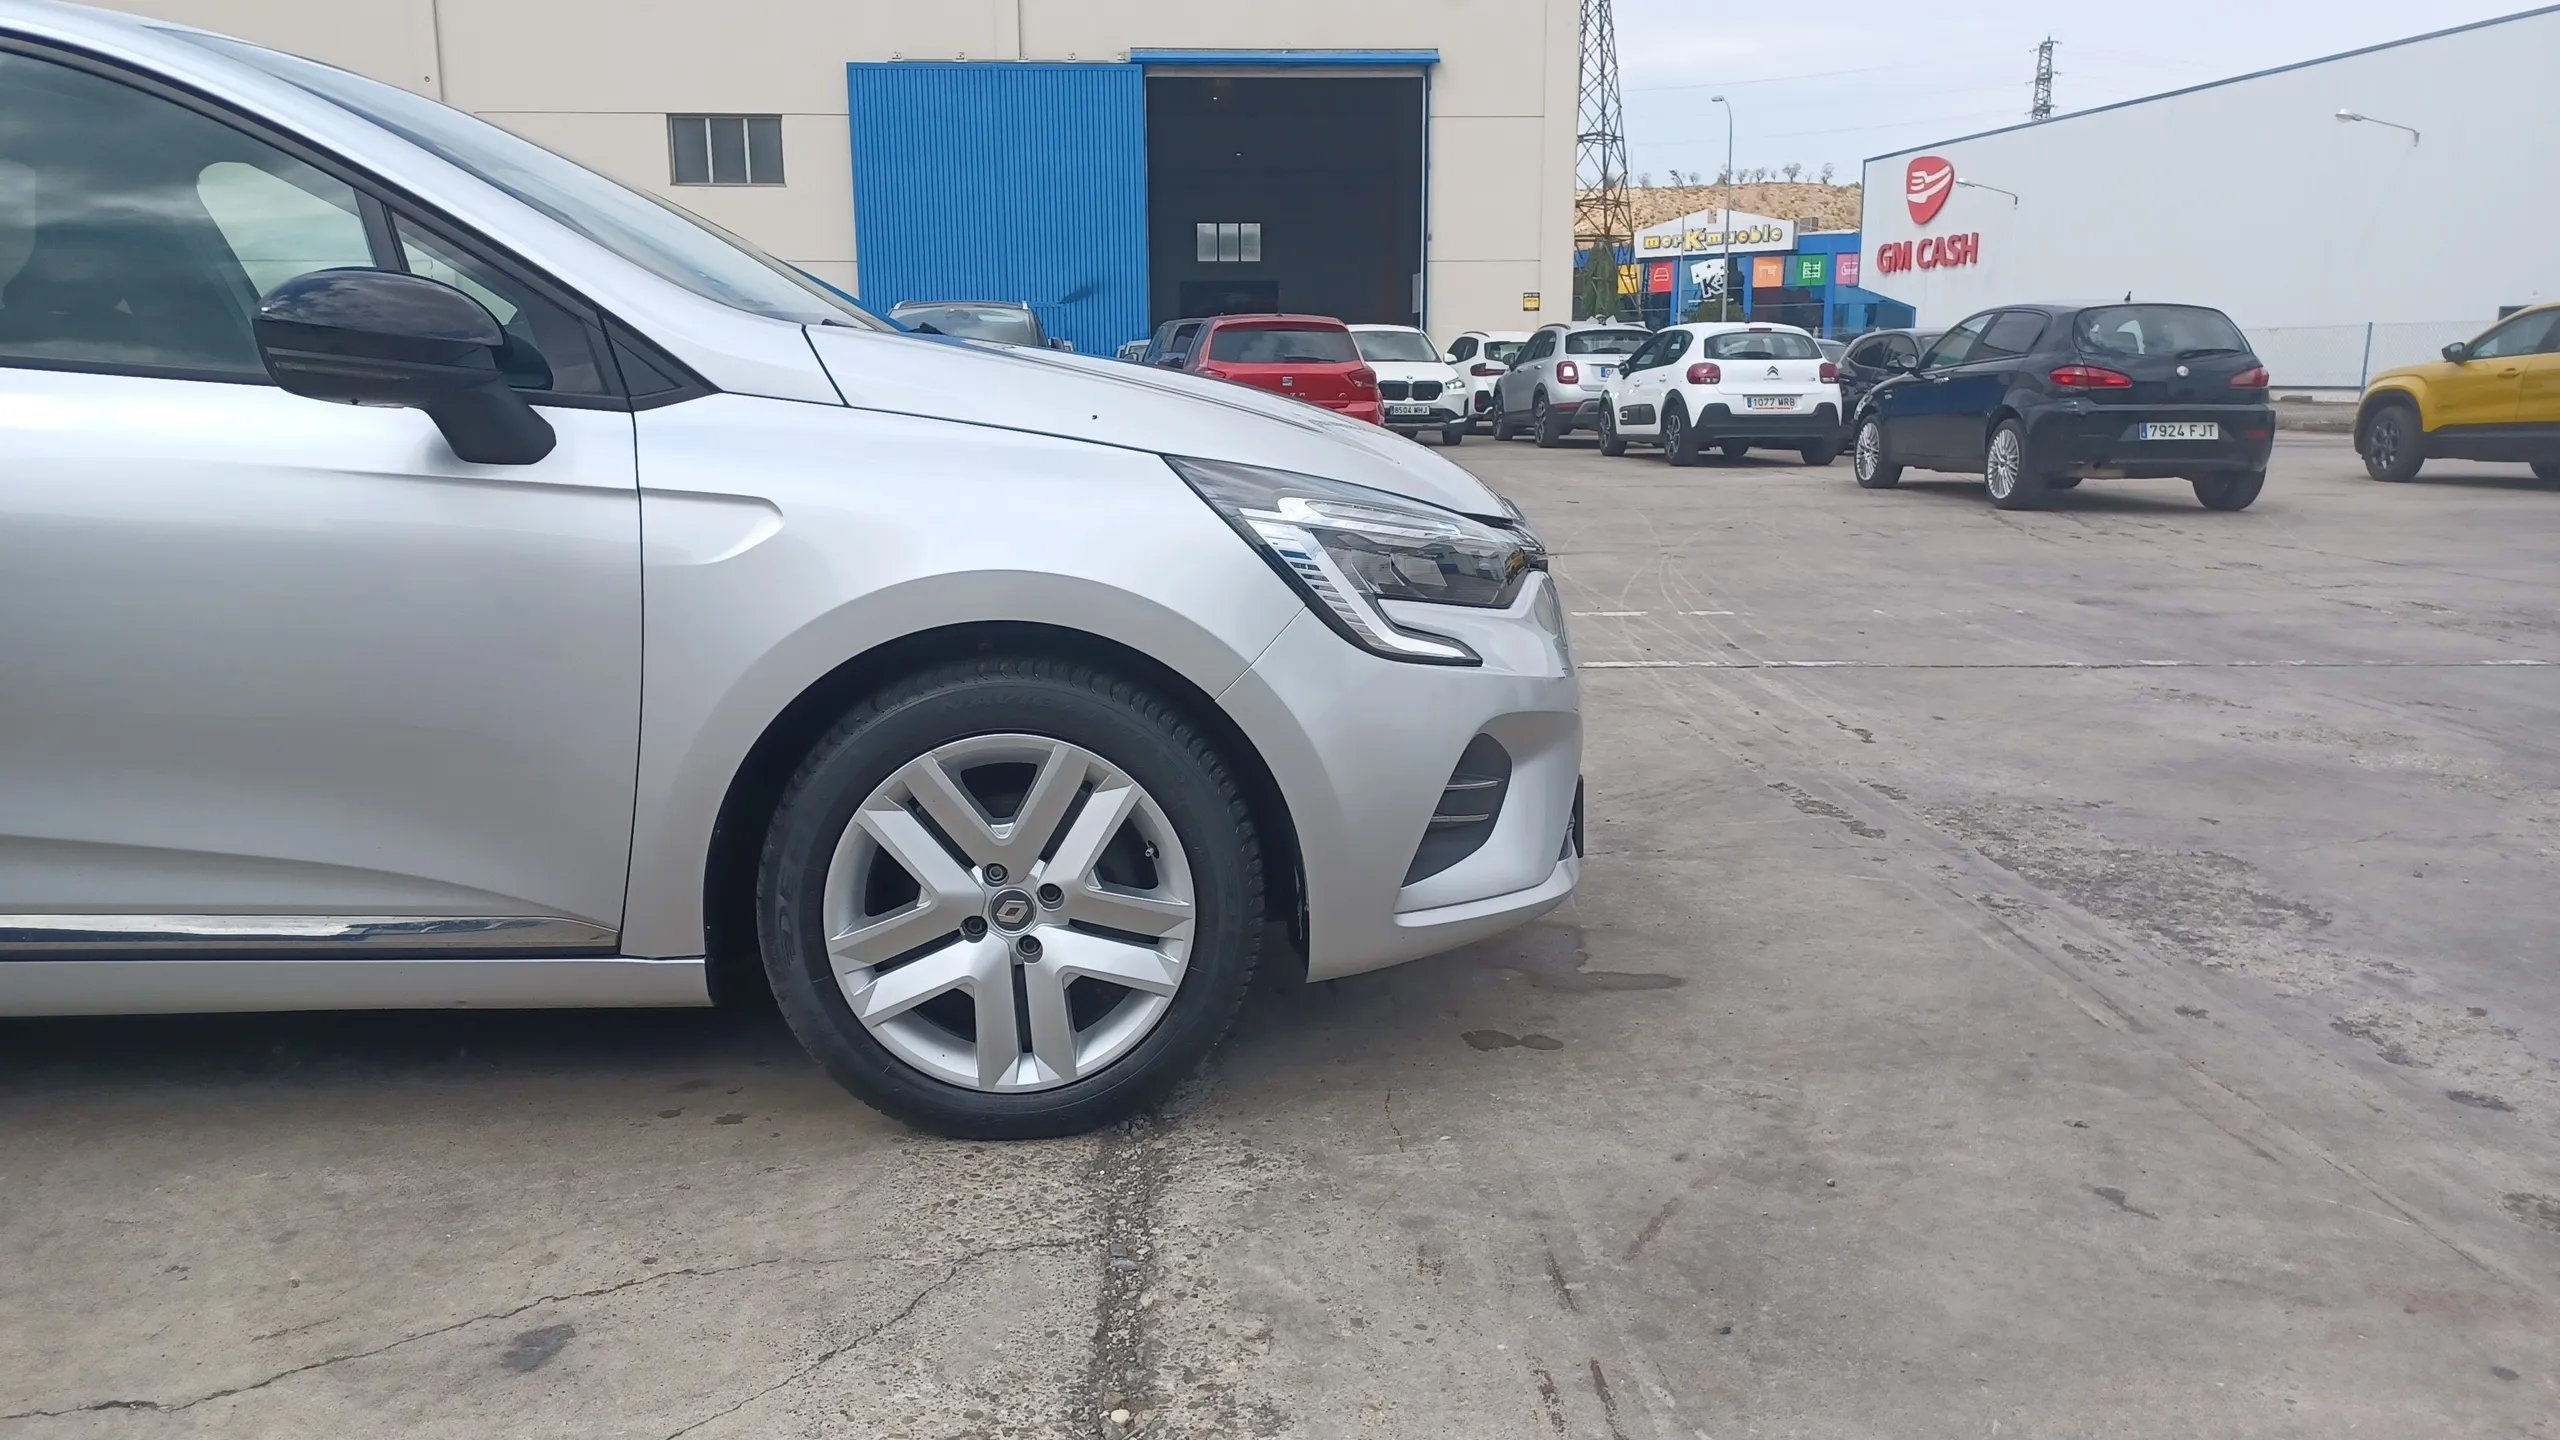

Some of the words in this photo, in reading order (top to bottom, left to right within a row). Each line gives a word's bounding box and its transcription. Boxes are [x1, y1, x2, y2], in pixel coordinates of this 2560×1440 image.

[1877, 241, 1912, 273] GM
[1916, 232, 1979, 269] CASH
[1753, 398, 1776, 407] 1077
[1778, 398, 1796, 407] MRB
[1394, 406, 1412, 414] 8504
[2149, 424, 2185, 437] 7924
[2189, 424, 2215, 437] FJT
